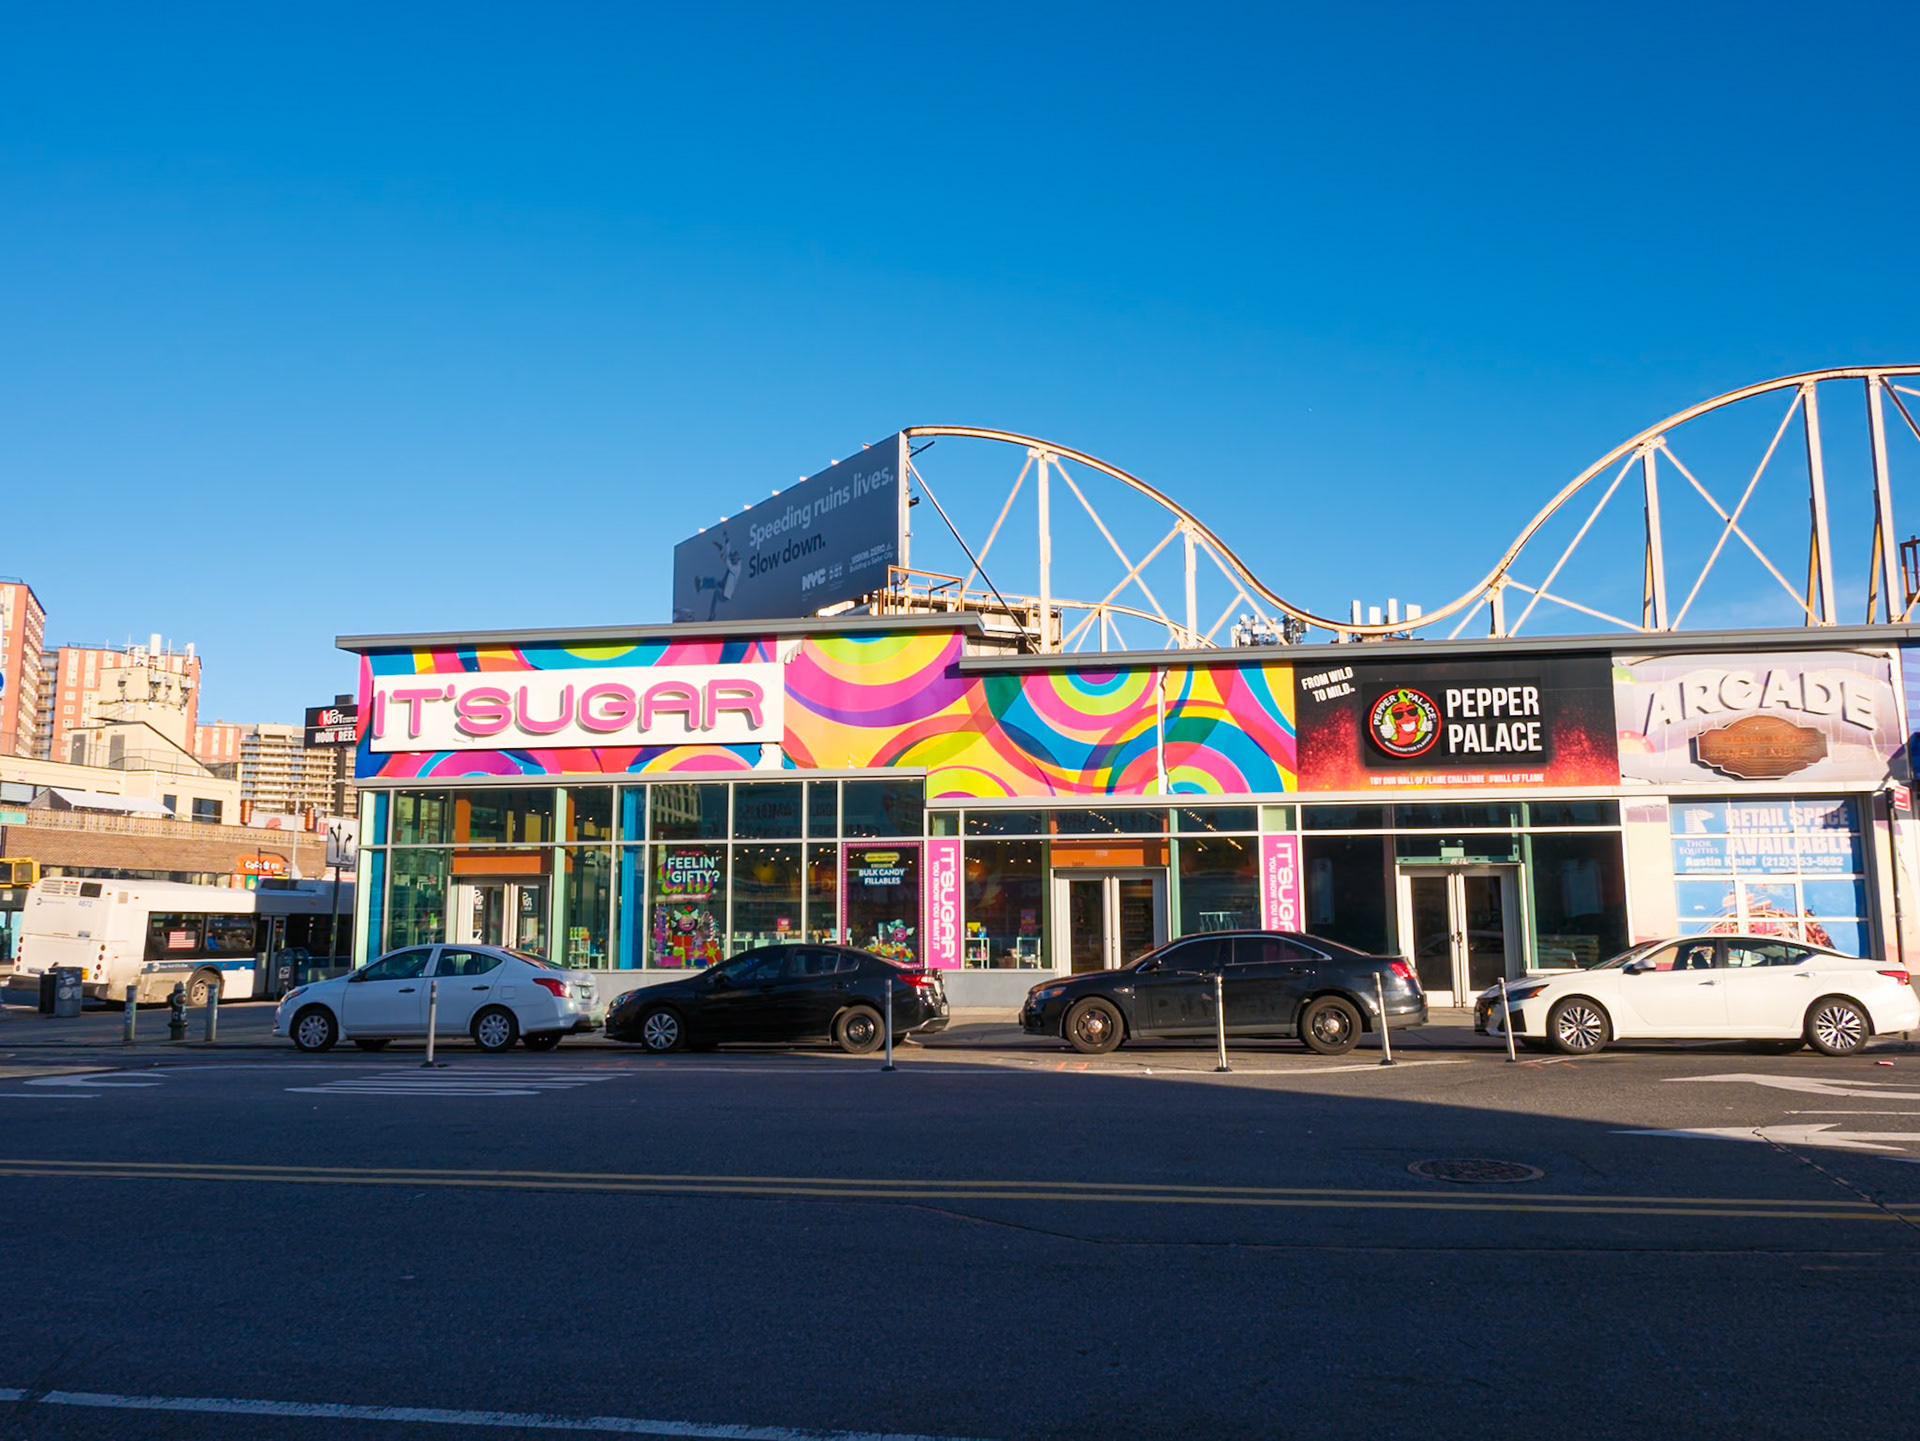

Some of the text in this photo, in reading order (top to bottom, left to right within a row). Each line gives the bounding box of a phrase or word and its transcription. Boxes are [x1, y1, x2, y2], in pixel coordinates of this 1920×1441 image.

[749, 466, 894, 549] Speeding ruins lives.
[749, 534, 826, 578] Slow down.
[802, 568, 826, 591] NYC
[1301, 666, 1353, 690] FROM WILD
[374, 678, 765, 737] IT'SUGAR
[1312, 689, 1327, 702] TO
[1446, 686, 1540, 718] PEPPER
[1643, 669, 1879, 736] ARCADE
[1373, 692, 1437, 725] PEPPER PALACE
[338, 730, 357, 742] REEL
[1448, 722, 1542, 753] PALACE
[1725, 807, 1849, 826] RETAIL SPACE
[1726, 827, 1852, 854] AVAILABLE
[859, 868, 905, 876] BULK CANDY
[1685, 856, 1721, 866] Austin
[672, 870, 720, 882] GIFTY?
[865, 877, 900, 885] FILLABLES
